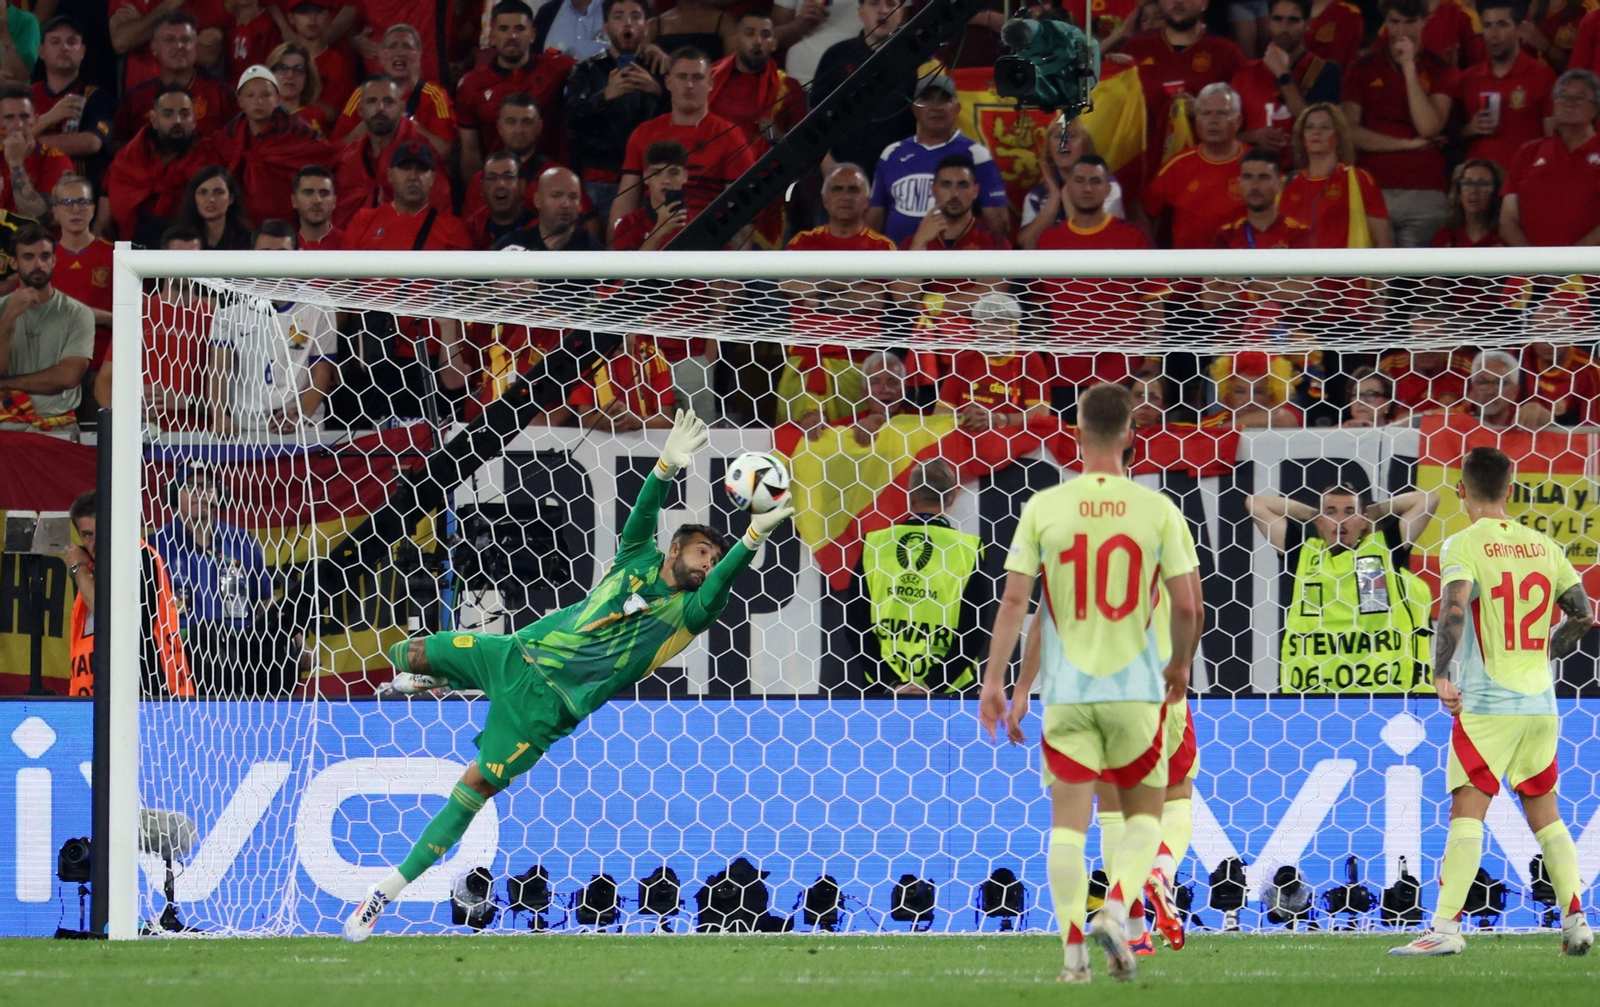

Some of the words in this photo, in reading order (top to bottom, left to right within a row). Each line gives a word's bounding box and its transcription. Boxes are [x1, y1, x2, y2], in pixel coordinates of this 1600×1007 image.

[1079, 501, 1126, 518] OLMO
[1484, 542, 1546, 559] GRIMALDO
[1059, 533, 1143, 622] 10
[1491, 571, 1551, 650] 12
[1288, 629, 1402, 657] STEWARD
[506, 742, 530, 764] 1
